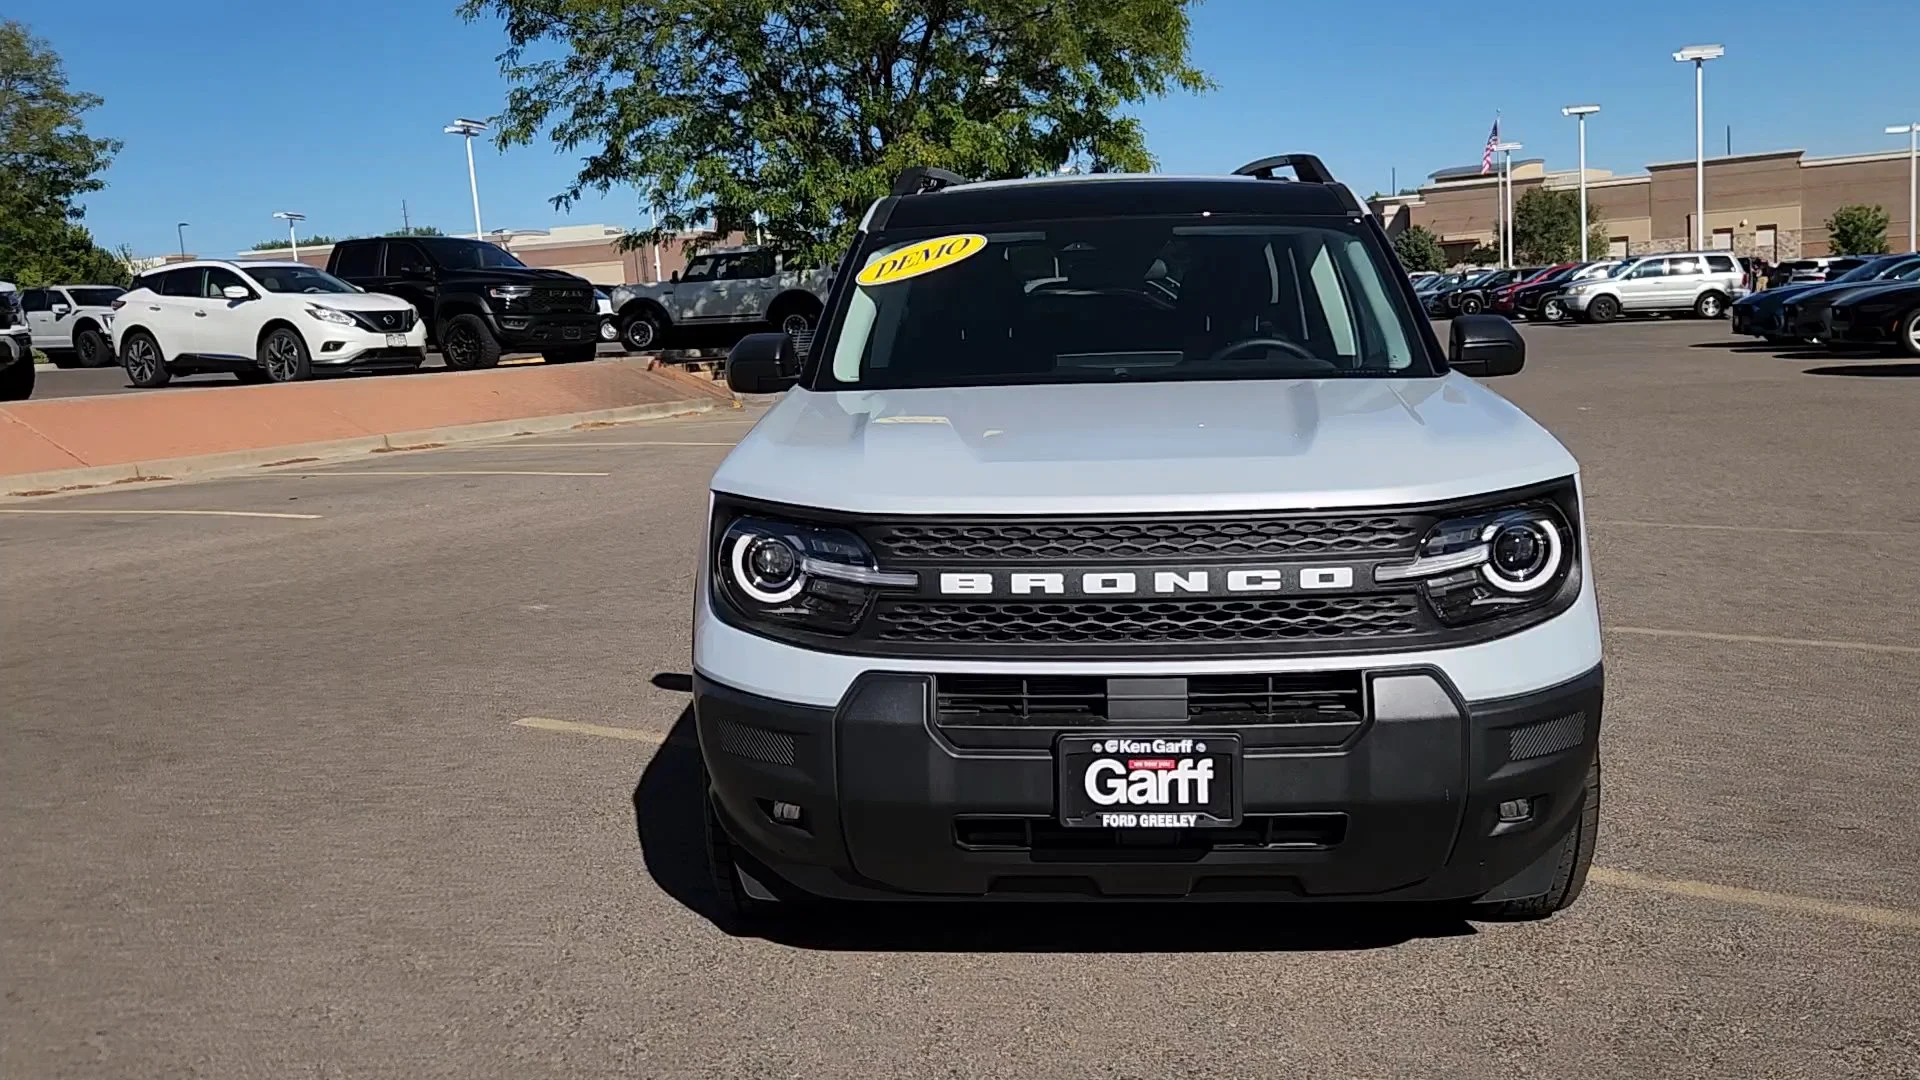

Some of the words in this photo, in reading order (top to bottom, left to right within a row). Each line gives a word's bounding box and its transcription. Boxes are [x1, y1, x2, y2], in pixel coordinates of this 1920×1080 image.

[873, 237, 971, 279] DEMO
[940, 567, 1353, 594] BRONCO
[1120, 740, 1151, 753] Ken
[1152, 739, 1193, 753] Garff
[1084, 758, 1214, 805] Garff
[1102, 814, 1138, 827] FORD
[1139, 814, 1197, 827] GREELEY
